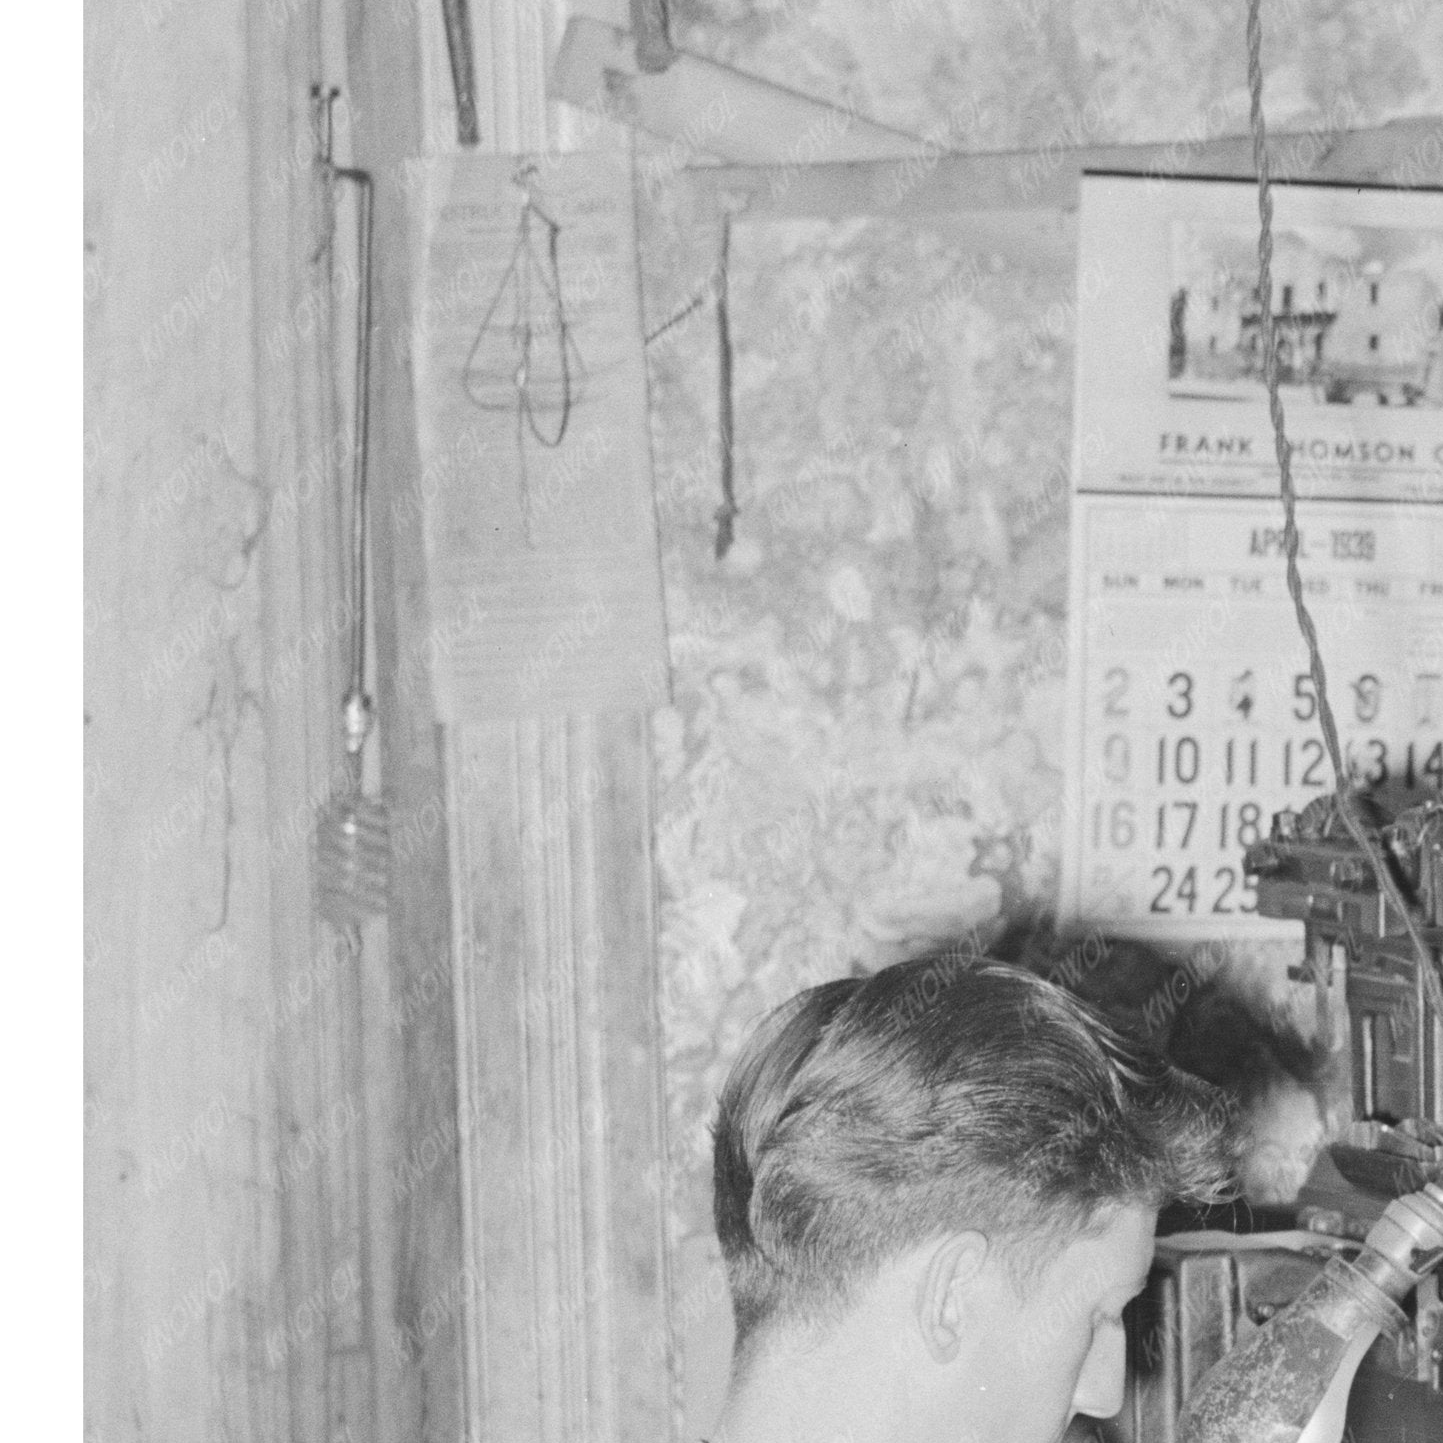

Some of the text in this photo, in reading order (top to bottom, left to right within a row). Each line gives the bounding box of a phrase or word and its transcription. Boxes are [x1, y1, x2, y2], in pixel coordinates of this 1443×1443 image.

[1158, 432, 1254, 456] FRANK
[1282, 436, 1416, 463] HOMSON
[1164, 576, 1204, 591] MON
[1103, 666, 1130, 717] 2
[1166, 672, 1193, 719] 3
[1294, 674, 1317, 722] 5
[1157, 736, 1199, 785] 10
[1225, 738, 1257, 786] 11
[1283, 739, 1326, 786] 12
[1093, 801, 1261, 850] 16 17 18
[1150, 865, 1198, 914] 24
